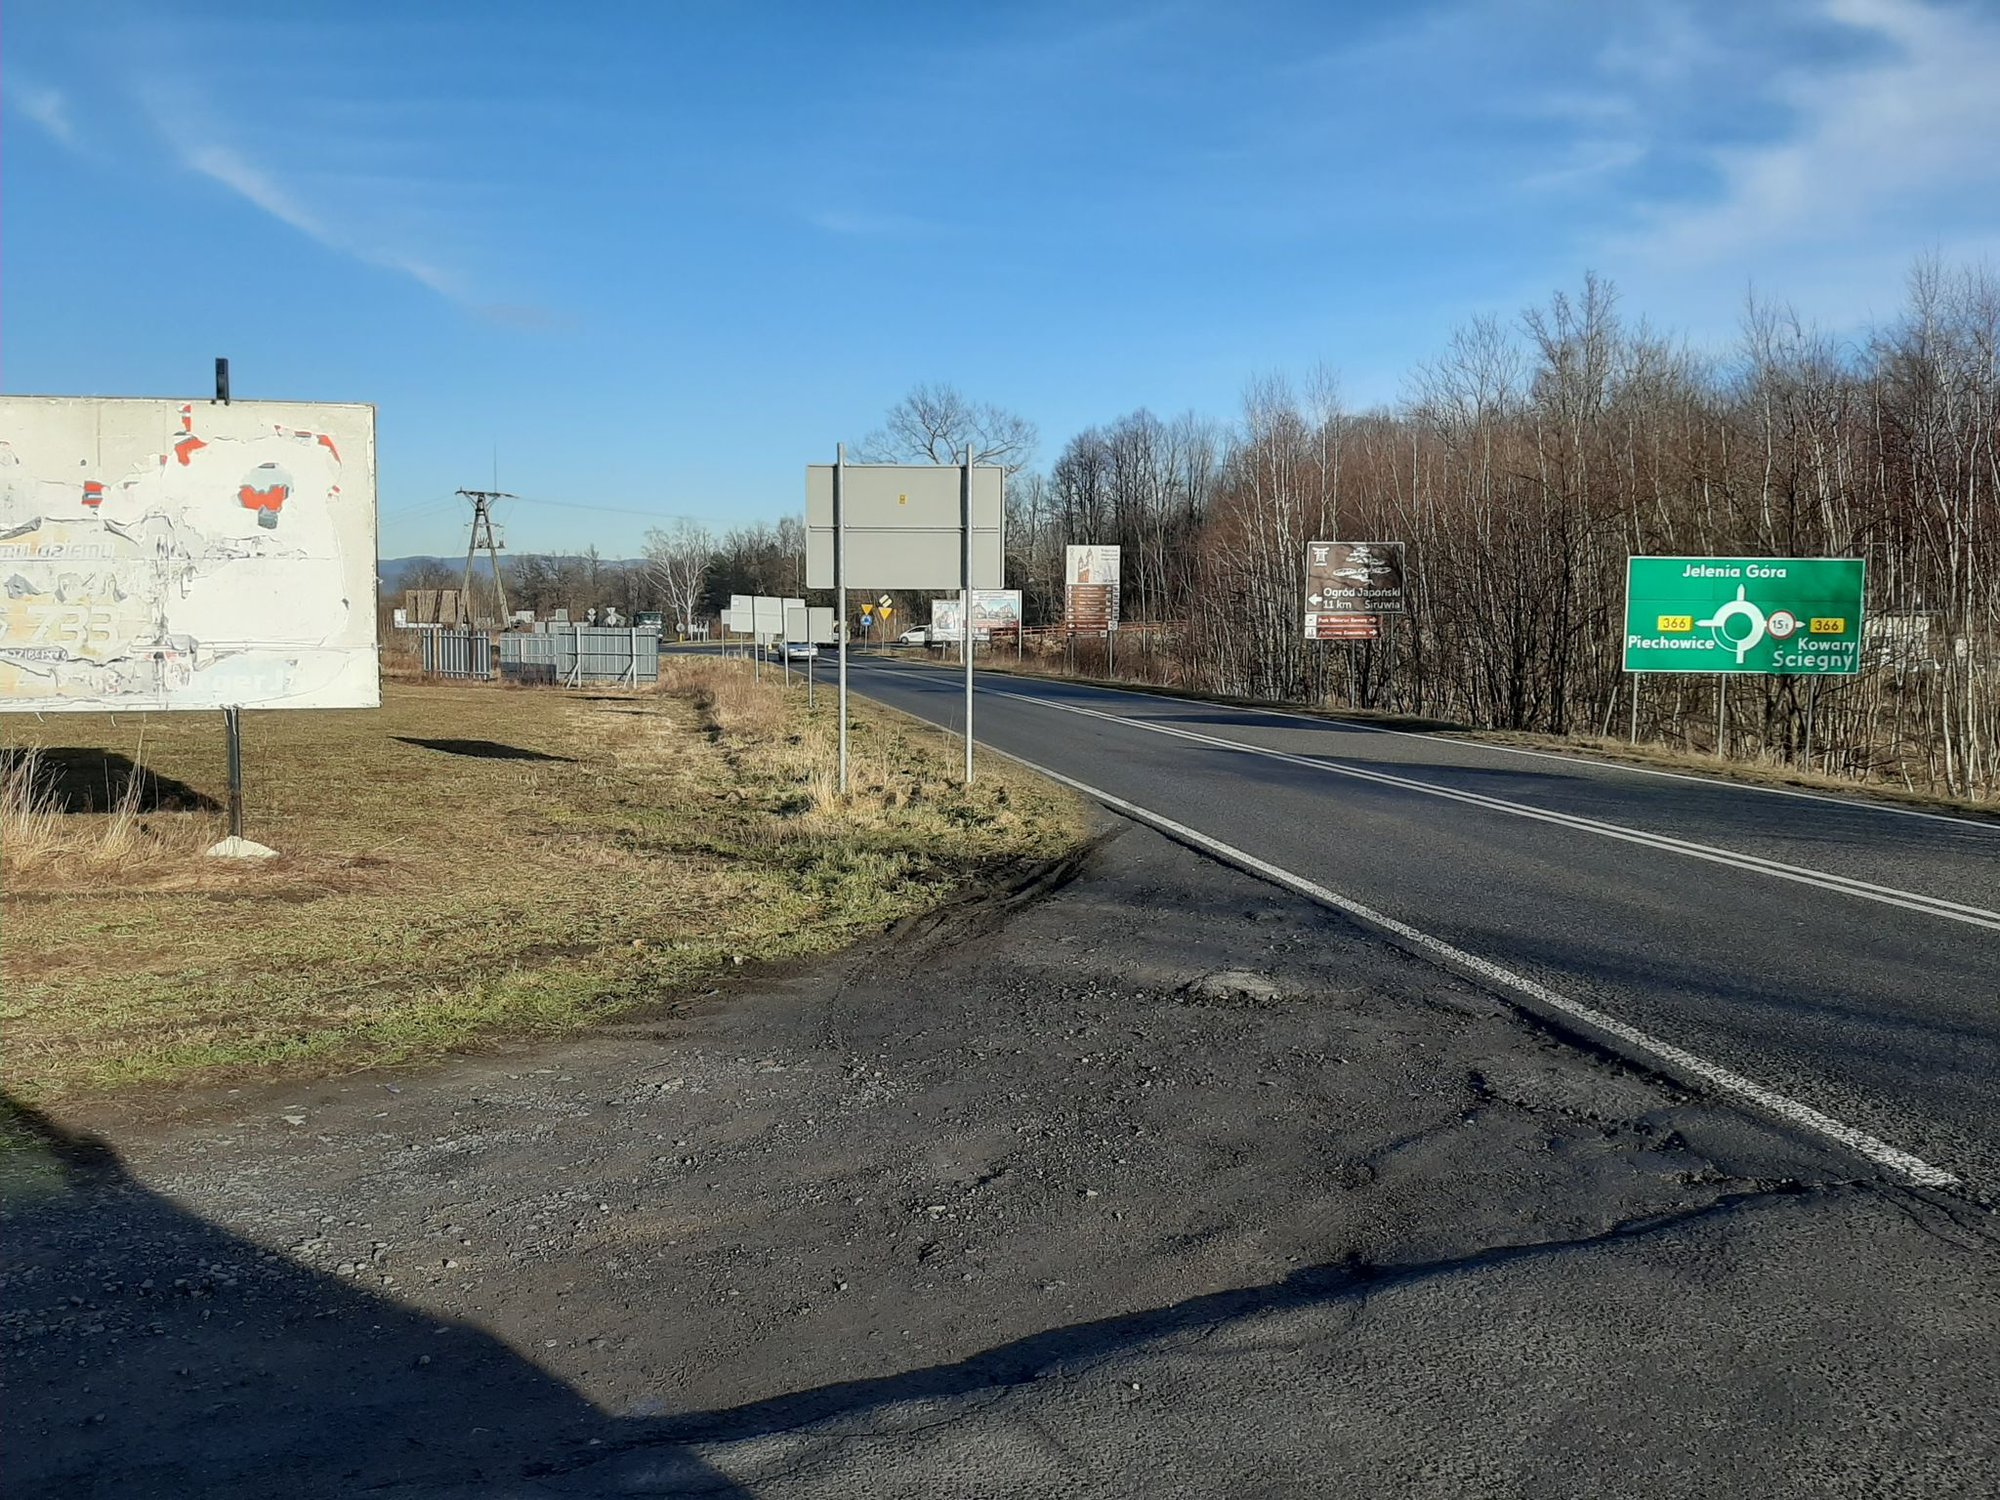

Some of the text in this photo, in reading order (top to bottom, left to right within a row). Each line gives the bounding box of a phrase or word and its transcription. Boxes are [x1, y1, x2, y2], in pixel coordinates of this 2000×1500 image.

[1682, 564, 1787, 579] Jelenia Góra
[1323, 587, 1401, 598] Ogród Japoński
[1323, 600, 1400, 609] 11 km Siruwia
[1663, 618, 1686, 629] 366
[1814, 620, 1839, 631] 366
[1628, 635, 1715, 649] Piechowice
[1798, 637, 1855, 655] Kowary
[1772, 645, 1853, 671] Ściegny
